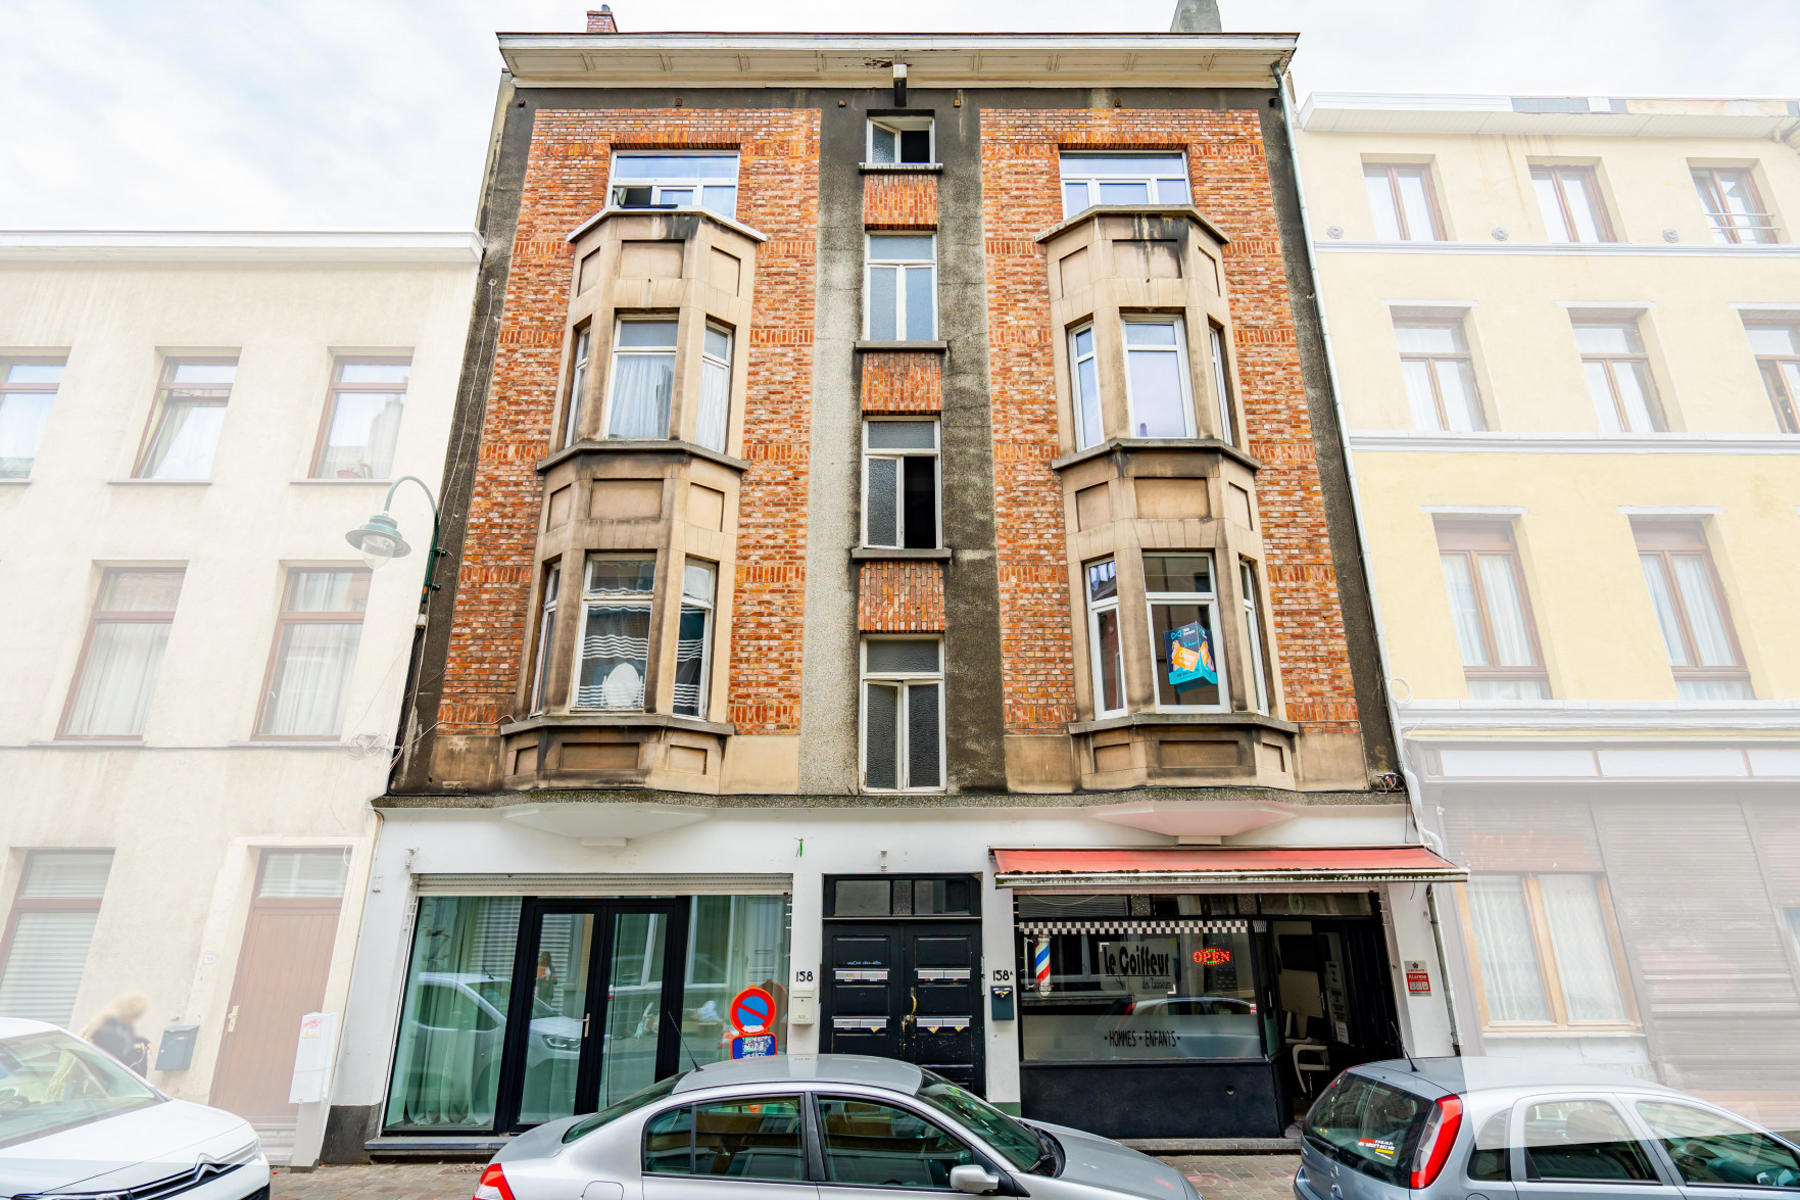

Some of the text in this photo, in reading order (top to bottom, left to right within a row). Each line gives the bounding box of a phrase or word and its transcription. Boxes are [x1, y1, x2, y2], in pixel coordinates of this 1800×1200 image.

[1119, 945, 1169, 976] Coiffeur
[1192, 950, 1231, 962] OPEN
[795, 970, 814, 982] 158
[1109, 1030, 1176, 1047] HOMMES ENFANTS
